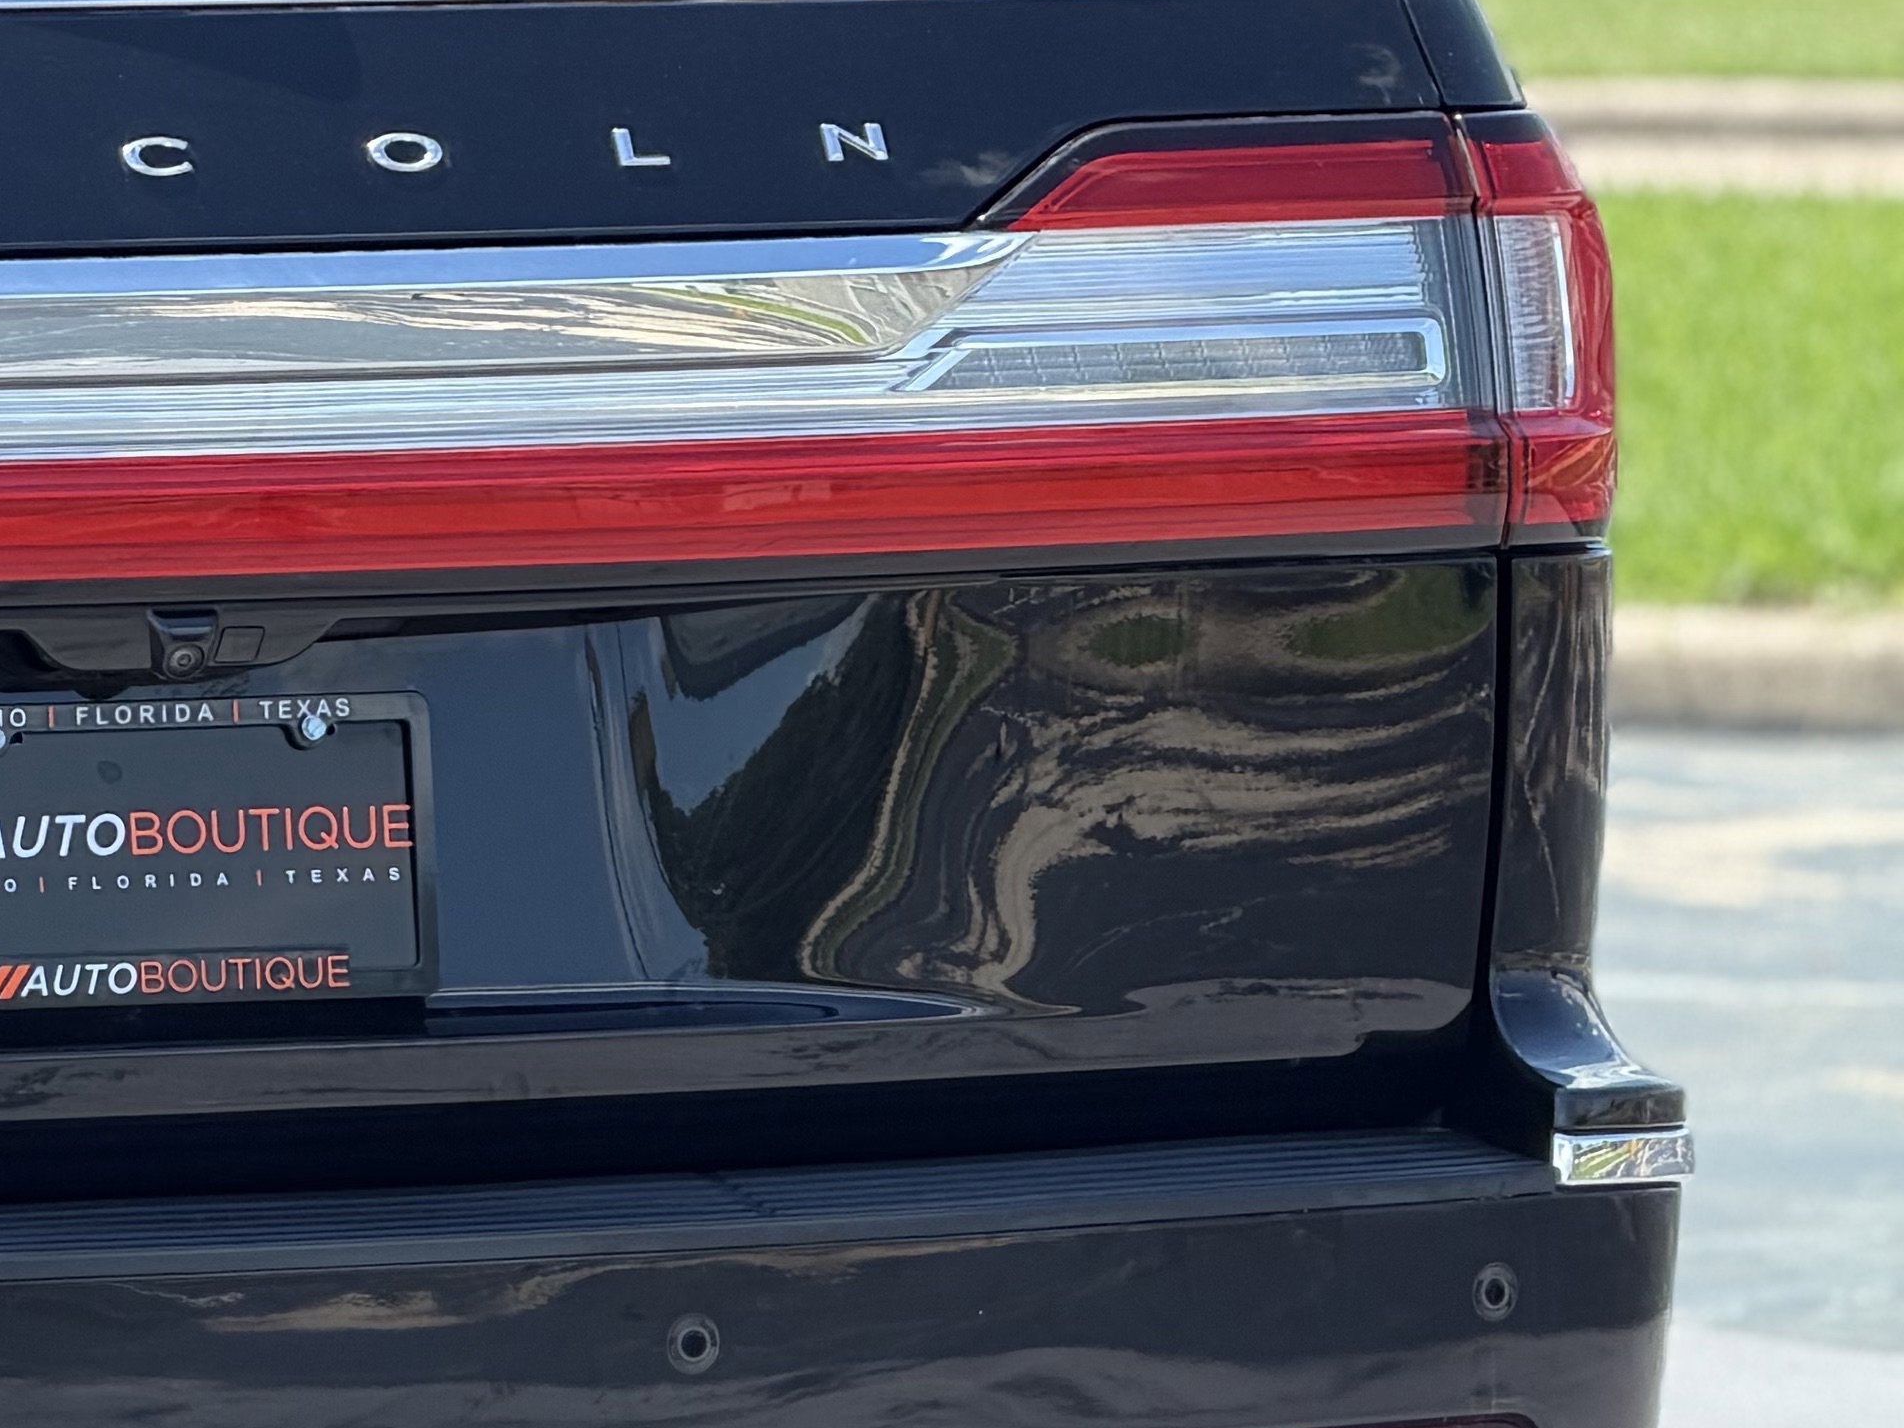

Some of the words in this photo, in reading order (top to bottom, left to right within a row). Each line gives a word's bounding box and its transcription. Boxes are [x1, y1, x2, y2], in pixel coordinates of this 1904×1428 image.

[76, 702, 215, 726] FLORIDA
[259, 697, 351, 720] TEXAS
[68, 872, 230, 891] FLORIDA
[285, 867, 401, 885] TEXAS
[21, 955, 350, 997] AUTOBOUTIQUE
